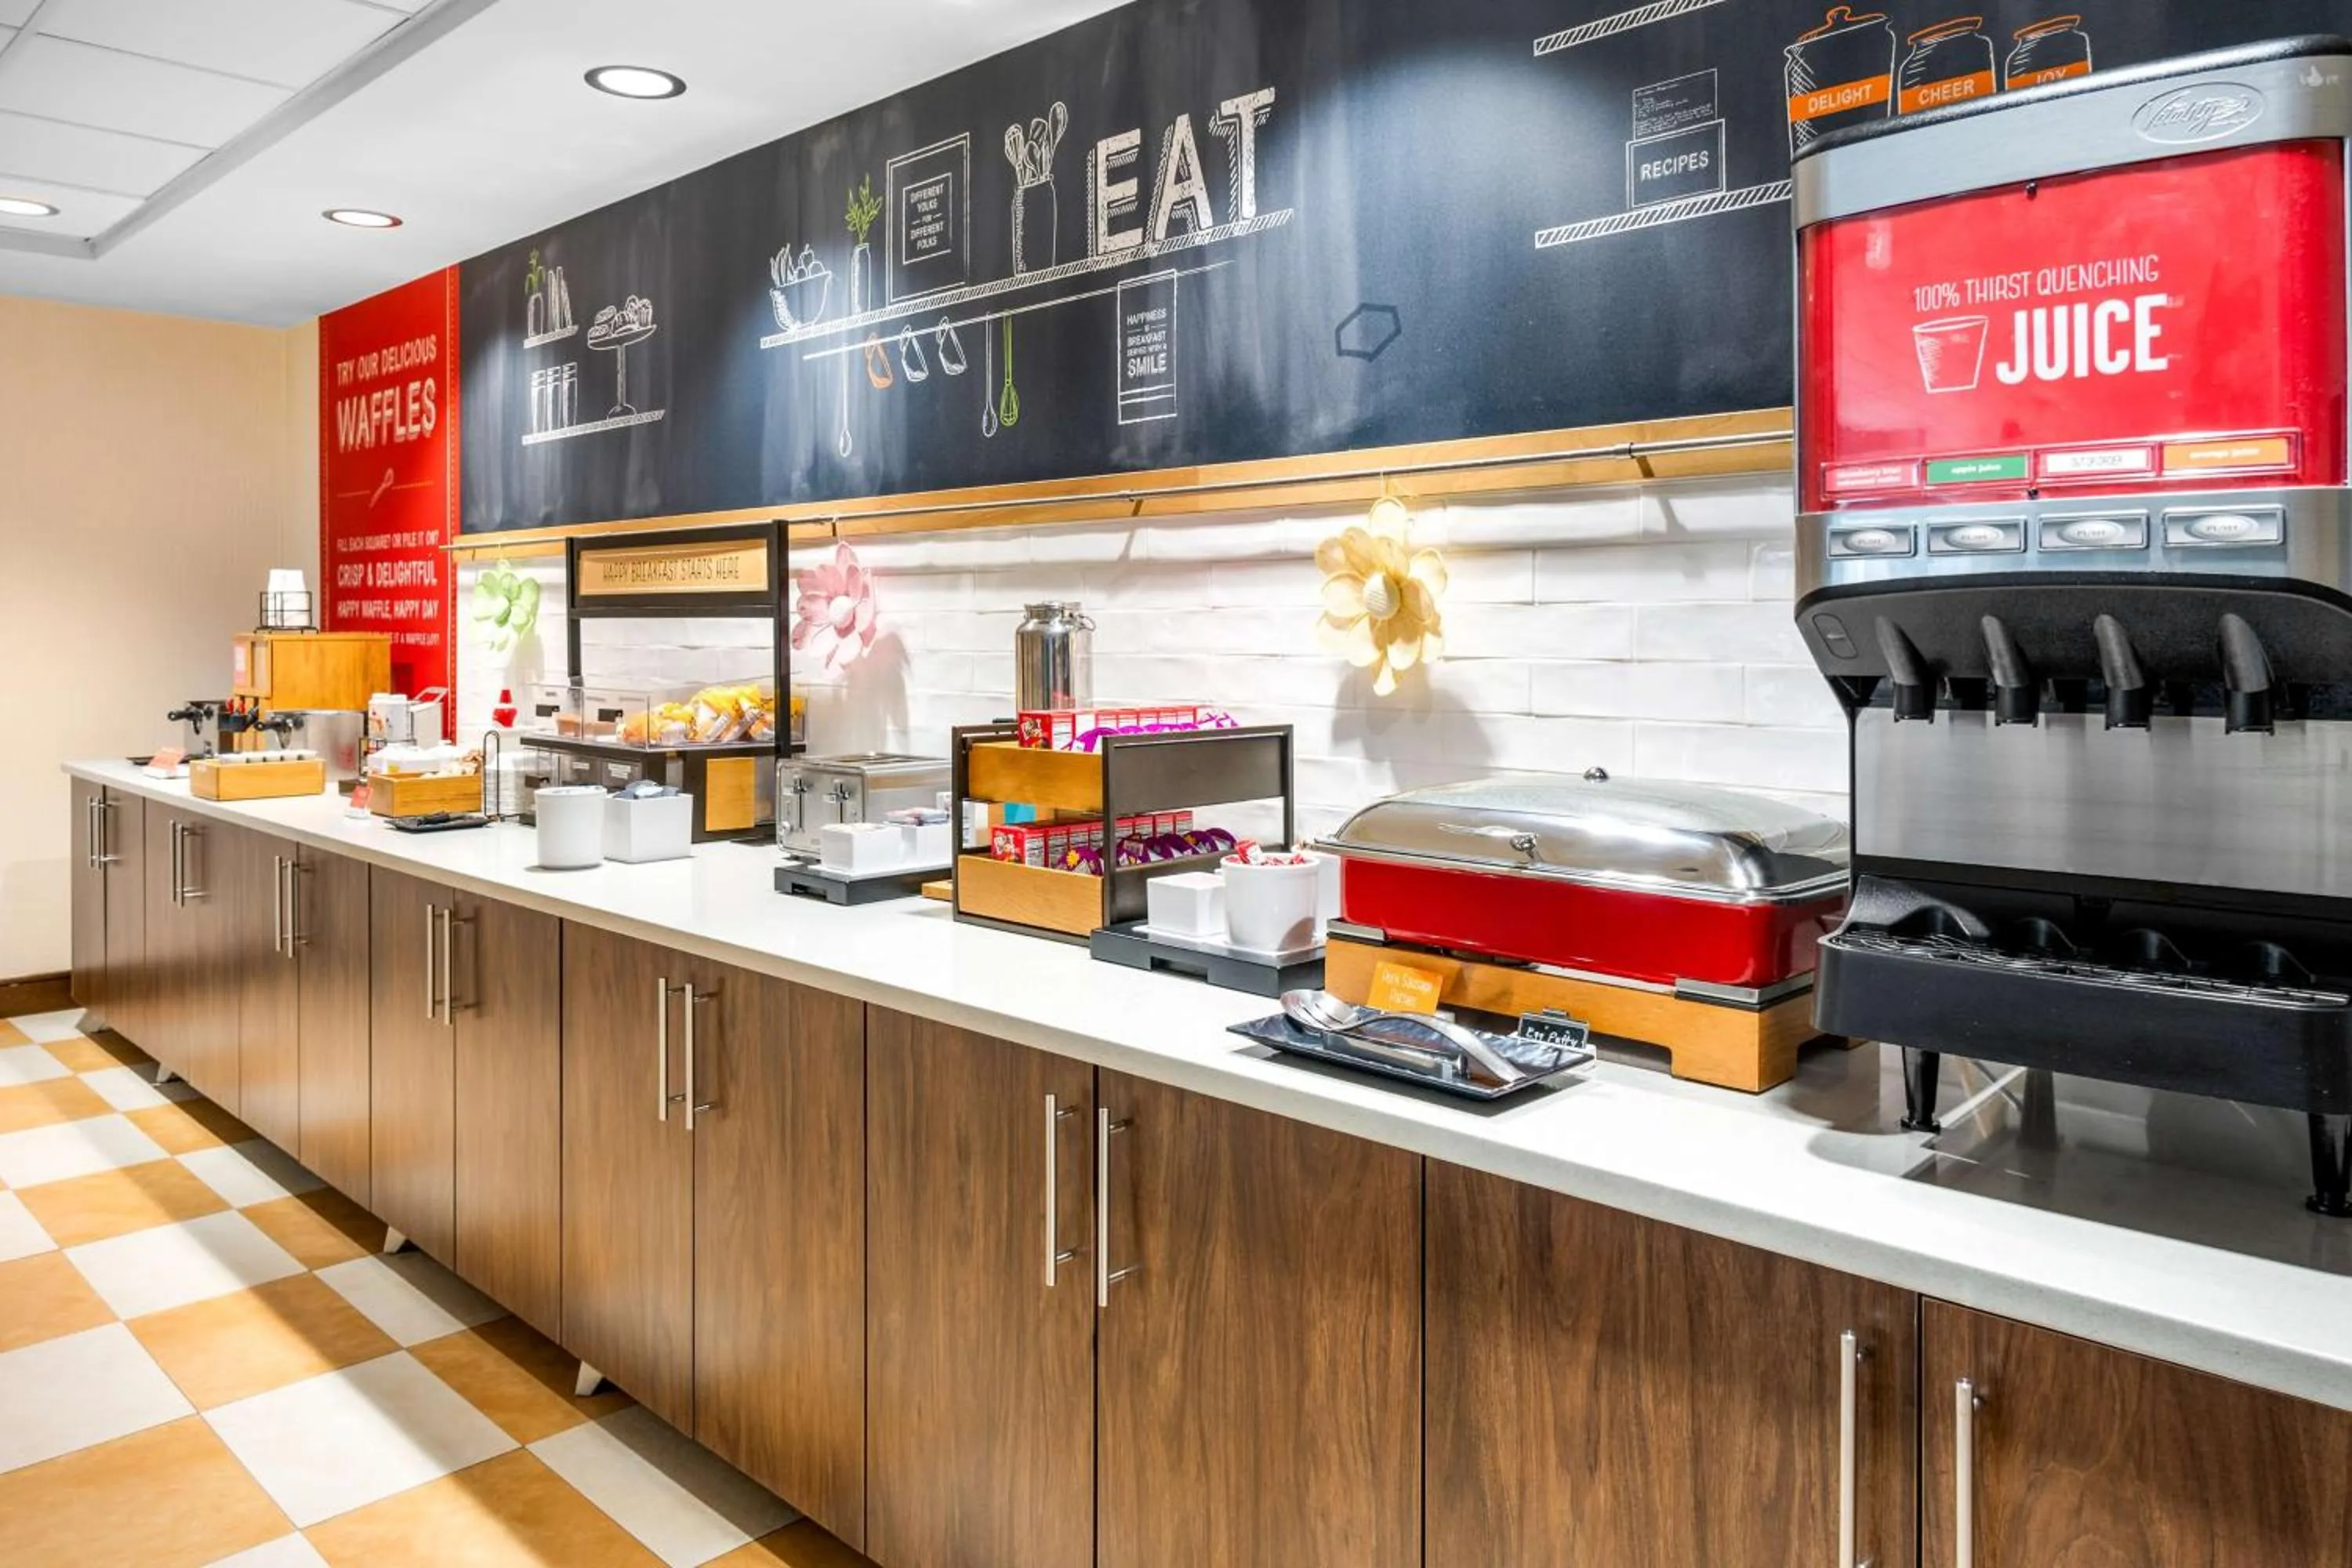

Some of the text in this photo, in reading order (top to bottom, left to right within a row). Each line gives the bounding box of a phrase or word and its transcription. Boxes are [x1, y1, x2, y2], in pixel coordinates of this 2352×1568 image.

[1808, 84, 1873, 114] DELIGHT
[1918, 78, 1976, 105] CHEER
[1088, 86, 1276, 256] EAT
[1640, 150, 1709, 182] RECIPES
[910, 183, 944, 204] DIFFERENT
[910, 221, 944, 240] DIFFERENT
[916, 236, 938, 251] FOLKS
[1914, 254, 2159, 312] 100% THIRST QUENCHING
[1127, 307, 1167, 326] HAPPINESS
[1127, 330, 1167, 347] BREAKFAST
[1996, 293, 2168, 384] JUICE
[337, 334, 437, 386] TRY OUR DELICIOUS
[1127, 352, 1167, 378] SMILE
[336, 377, 437, 453] WAFFLES
[338, 563, 364, 587] CRISP
[367, 561, 374, 586] &
[603, 557, 739, 583] HAPPY BREAKFAST STARTS HERE
[337, 600, 360, 619] HAPPY
[394, 599, 420, 619] HAPPY
[422, 598, 439, 620] DAY
